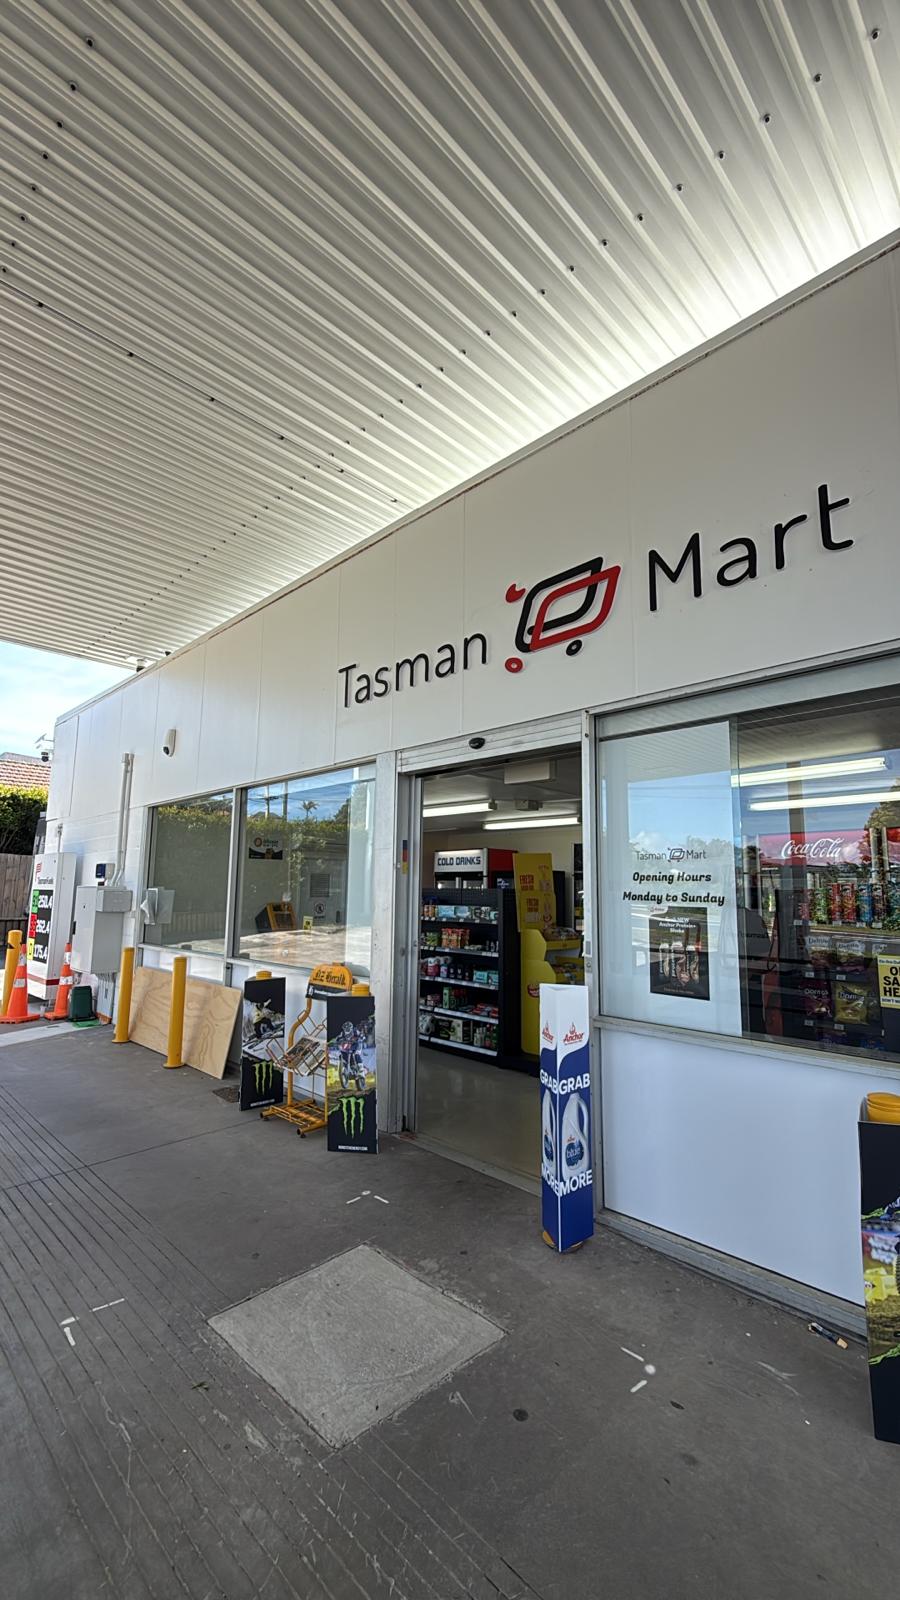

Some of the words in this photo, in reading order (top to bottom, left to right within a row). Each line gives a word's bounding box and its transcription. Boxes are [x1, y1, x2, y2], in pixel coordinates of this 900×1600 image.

[338, 633, 487, 708] Tasman
[648, 484, 854, 612] Mart
[636, 850, 666, 860] Tasman
[686, 850, 706, 860] Mart
[781, 838, 844, 859] Coca-Cola
[437, 857, 454, 866] COLD
[455, 856, 481, 866] DRINKS
[632, 872, 674, 884] Opening
[677, 872, 712, 881] Hours
[622, 891, 663, 904] Monday
[665, 893, 678, 902] to
[680, 892, 725, 906] Sunday
[563, 1032, 584, 1043] Anchor
[540, 1069, 559, 1095] GRAB
[559, 1073, 591, 1095] GRAB
[560, 1169, 593, 1197] MORE
